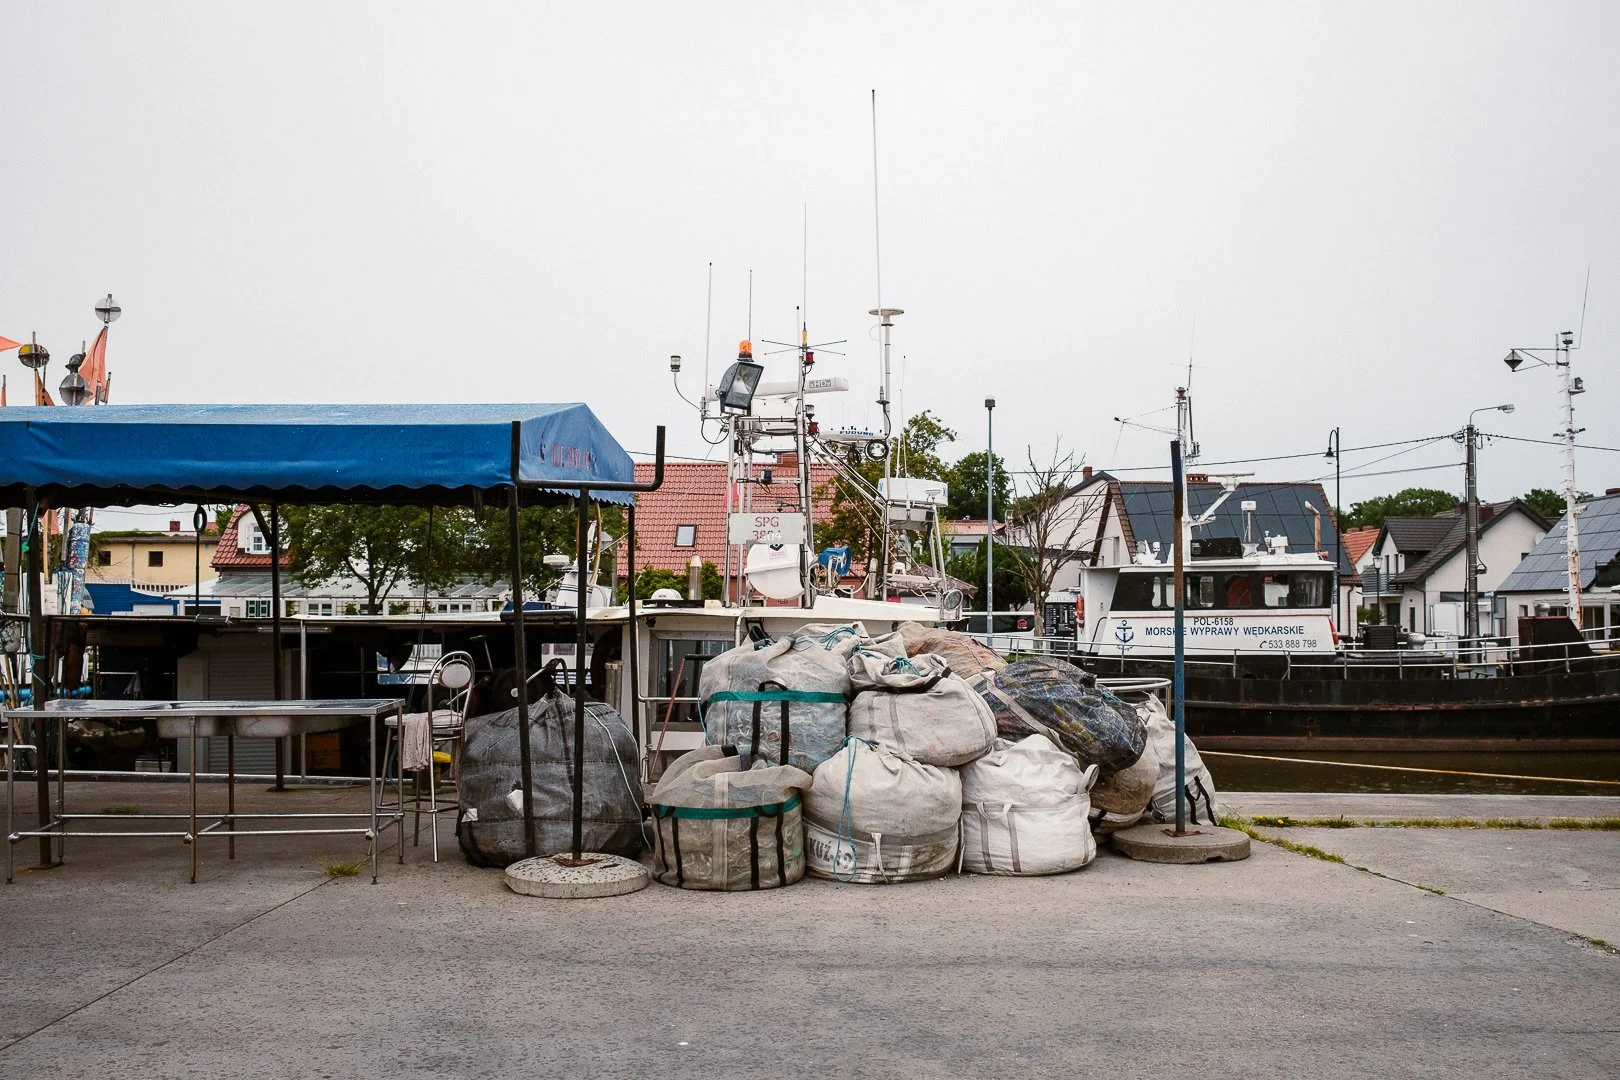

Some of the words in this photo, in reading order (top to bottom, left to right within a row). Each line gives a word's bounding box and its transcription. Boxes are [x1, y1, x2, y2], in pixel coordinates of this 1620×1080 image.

[754, 516, 779, 528] SPG
[752, 530, 781, 541] 3804
[1193, 617, 1234, 626] POL-6158
[1145, 627, 1187, 636] MORSE
[1190, 626, 1239, 636] WYPRAWY
[1243, 626, 1305, 637] WĘDKARSKIE
[1268, 640, 1283, 649] 533
[1285, 639, 1300, 648] 888
[1302, 639, 1317, 648] 798
